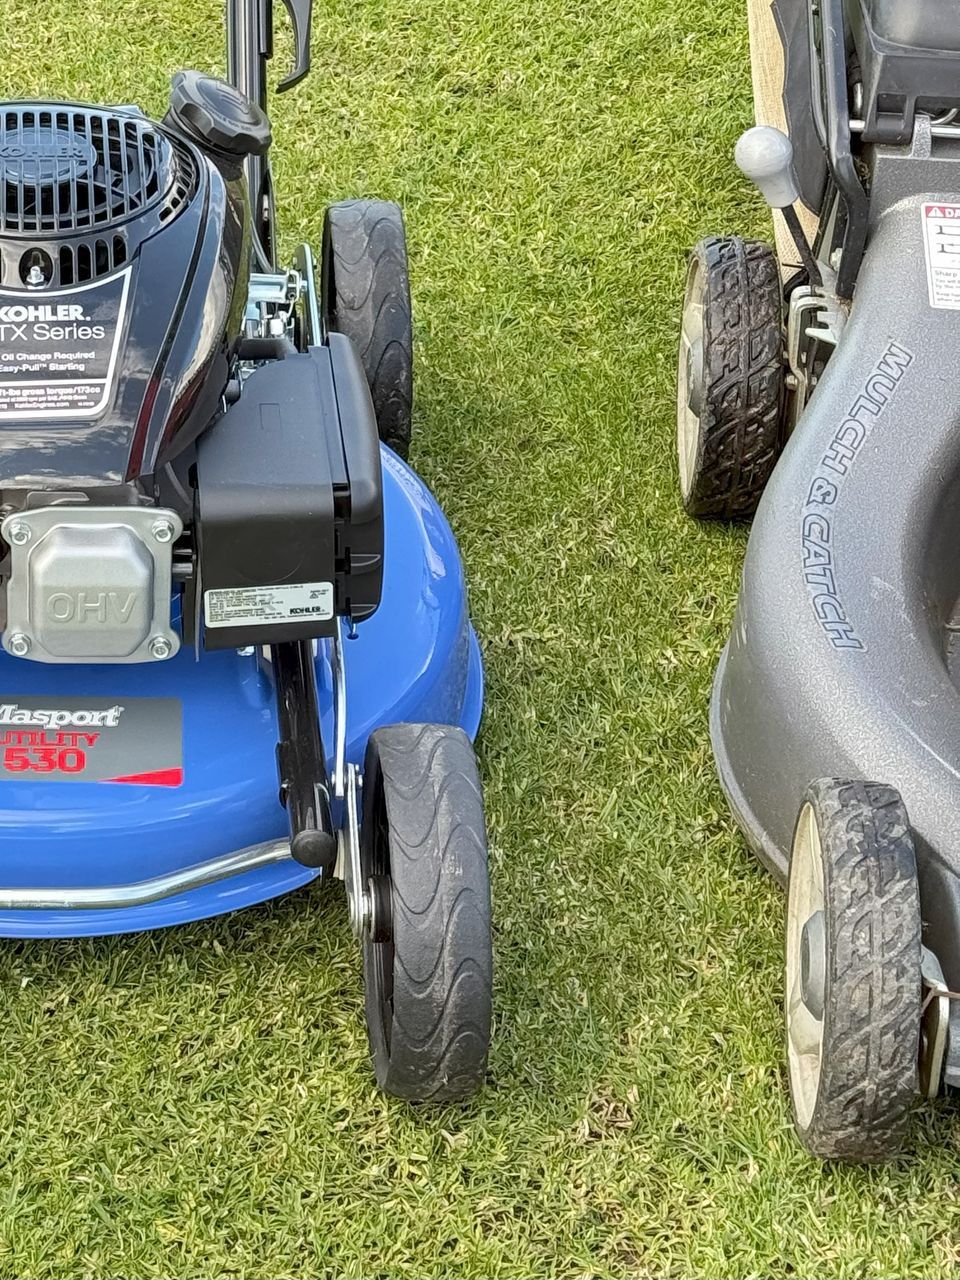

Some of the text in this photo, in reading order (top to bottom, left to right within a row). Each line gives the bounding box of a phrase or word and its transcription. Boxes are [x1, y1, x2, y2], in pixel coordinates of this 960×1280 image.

[33, 322, 106, 341] Series
[1, 353, 14, 361] Oil
[16, 352, 52, 362] Change
[53, 351, 96, 362] Required
[49, 362, 86, 372] Starting
[802, 343, 913, 649] MULCH & CATCH
[47, 592, 137, 624] OHV
[3, 747, 86, 773] 530
